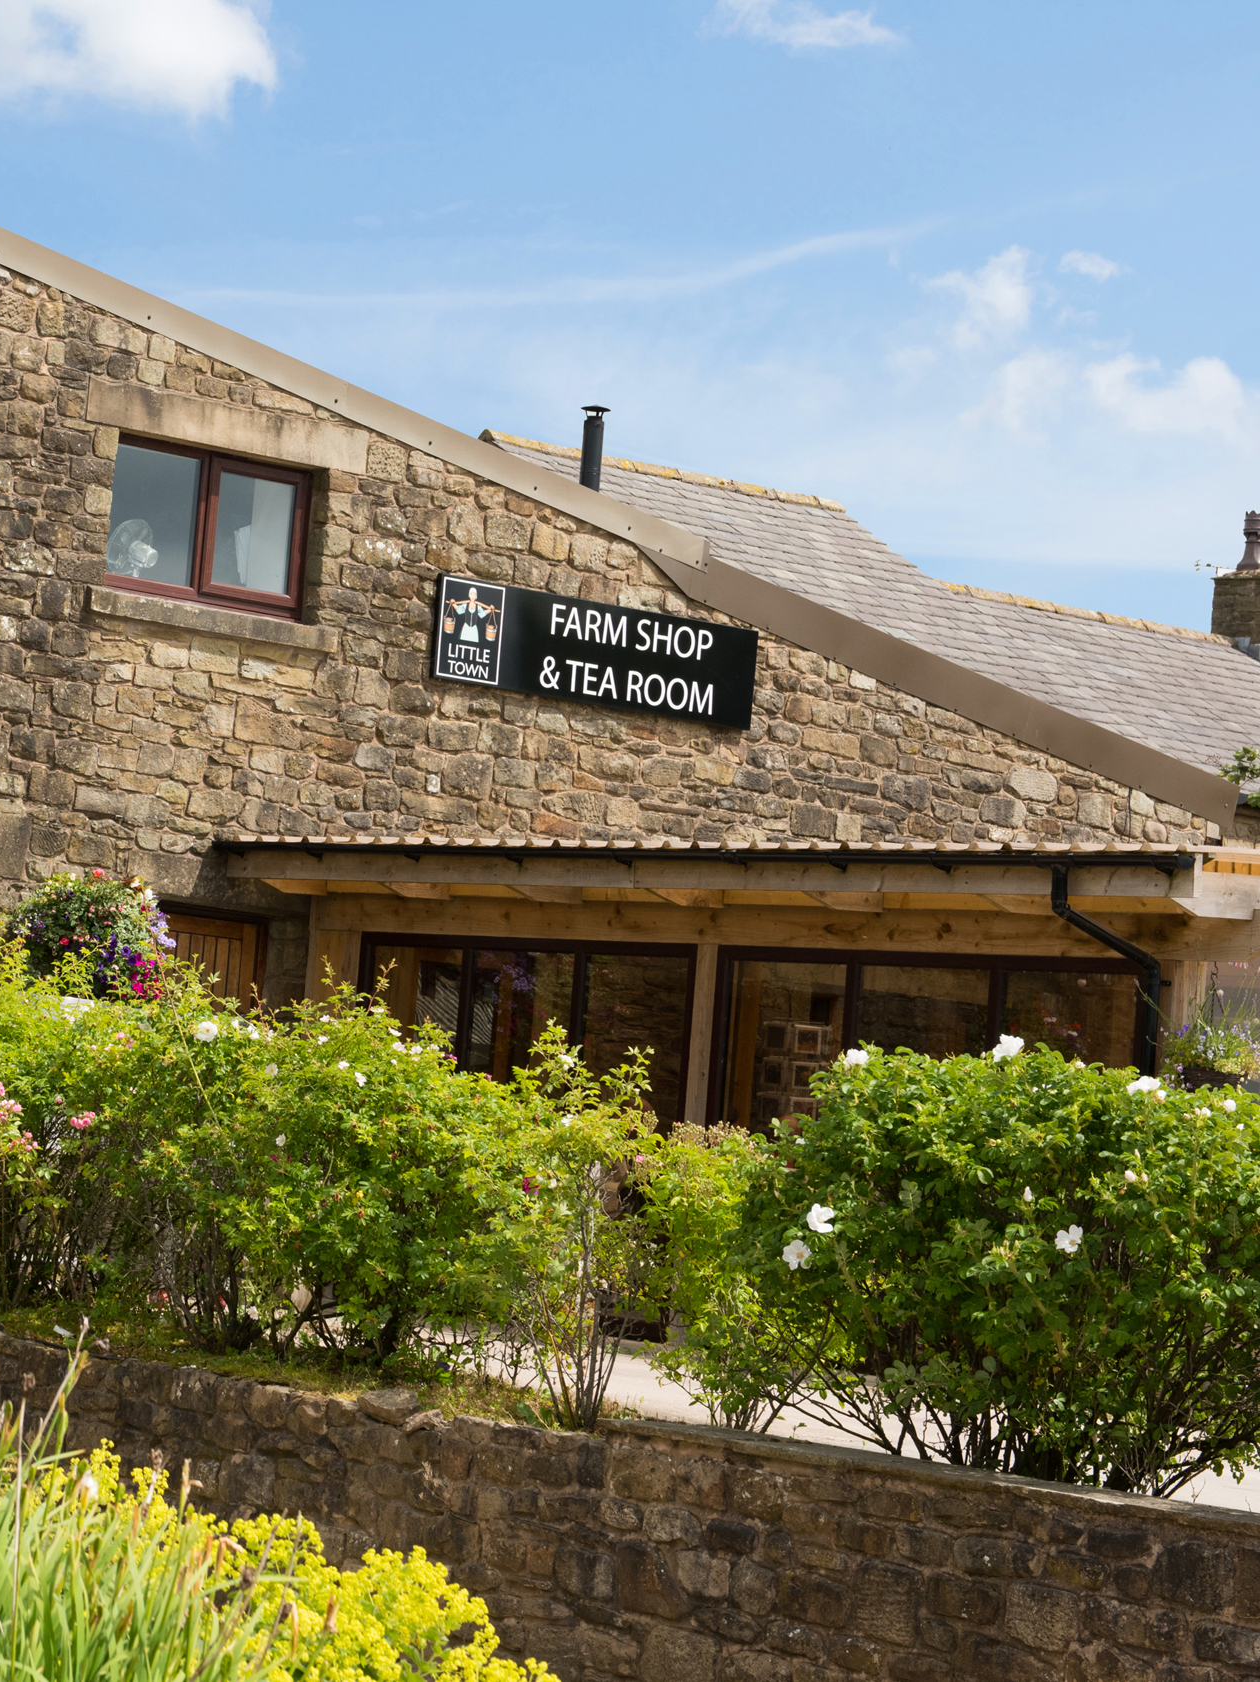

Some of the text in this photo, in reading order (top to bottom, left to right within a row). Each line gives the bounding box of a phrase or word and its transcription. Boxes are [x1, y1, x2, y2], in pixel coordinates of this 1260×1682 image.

[550, 603, 713, 661] FARM SHOP
[447, 660, 489, 679] TOWN
[448, 643, 491, 664] LITTLE
[539, 655, 714, 715] & TEA ROOM
